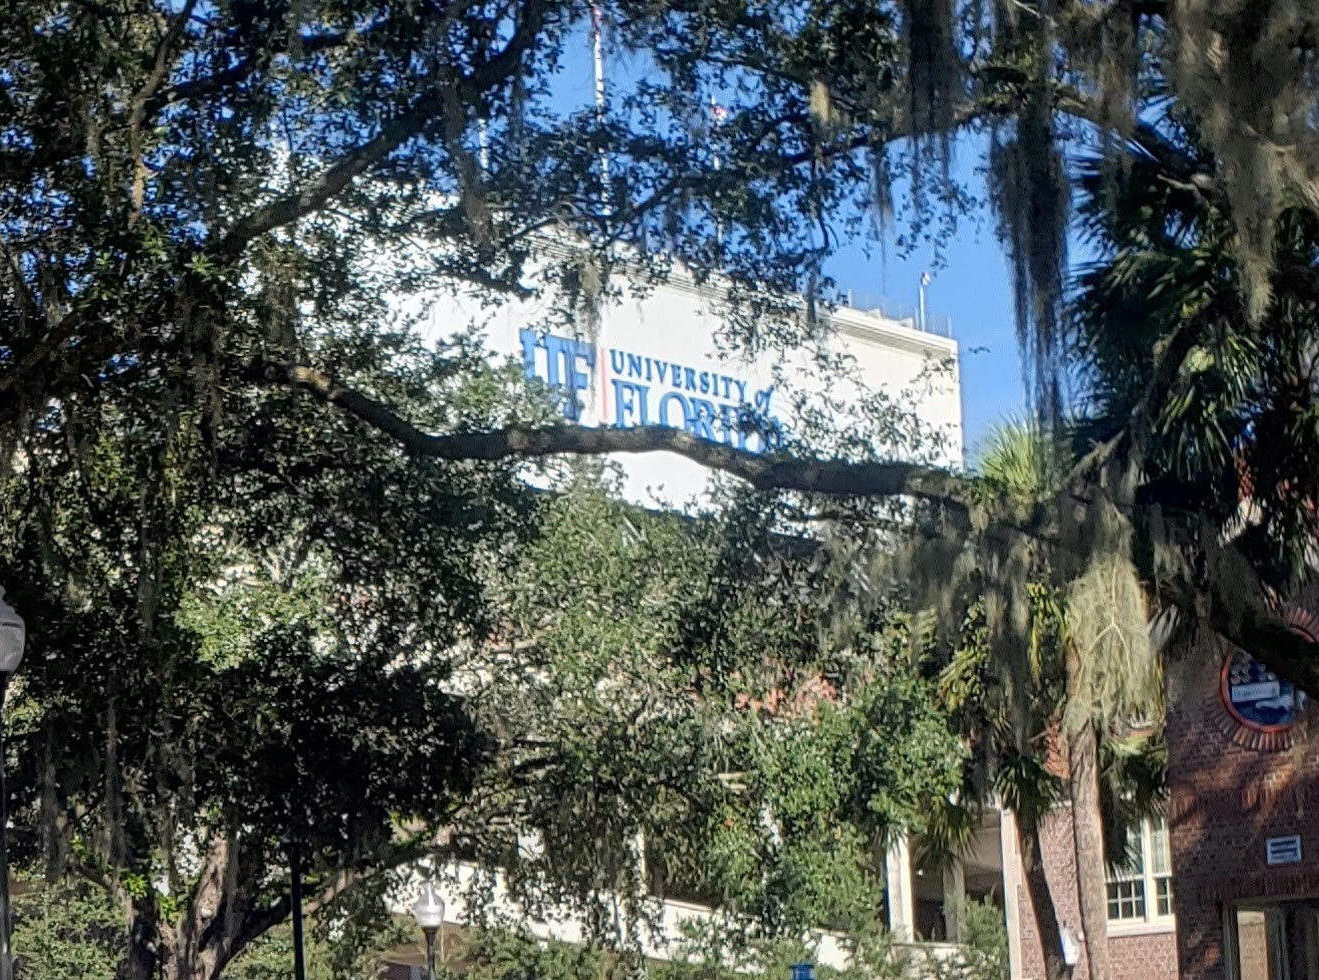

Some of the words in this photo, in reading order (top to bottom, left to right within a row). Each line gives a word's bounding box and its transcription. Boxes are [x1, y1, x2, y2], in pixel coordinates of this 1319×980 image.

[609, 348, 748, 403] UNIVERSITY
[753, 384, 776, 417] of
[610, 378, 782, 456] FLORI
